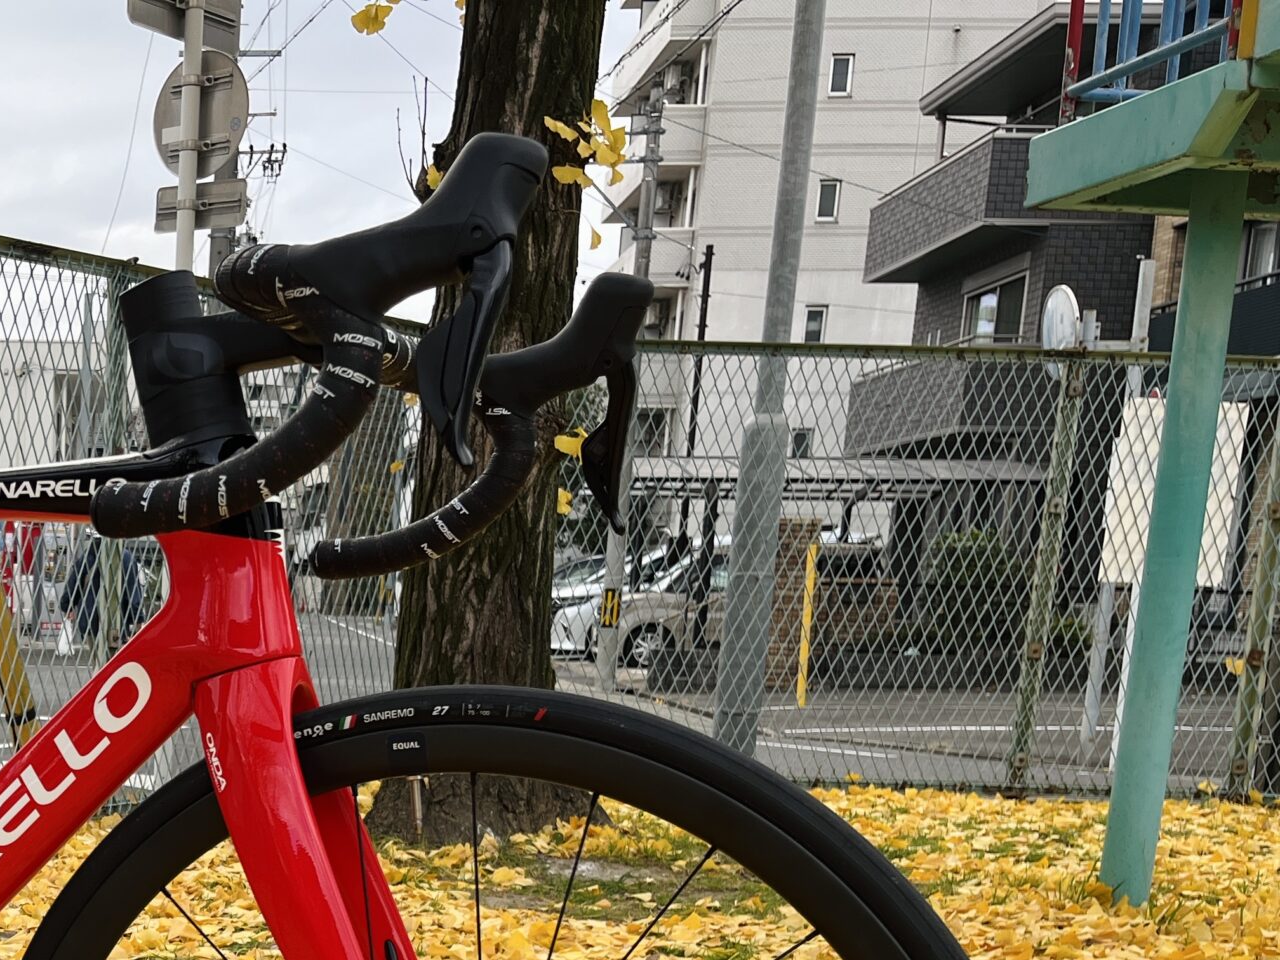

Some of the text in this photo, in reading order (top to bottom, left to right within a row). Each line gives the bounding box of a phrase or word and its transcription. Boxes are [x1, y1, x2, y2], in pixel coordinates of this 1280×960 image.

[363, 708, 414, 723] SANREMO
[431, 705, 450, 716] 27
[392, 741, 420, 751] EQUAL
[206, 732, 227, 791] ONDA
